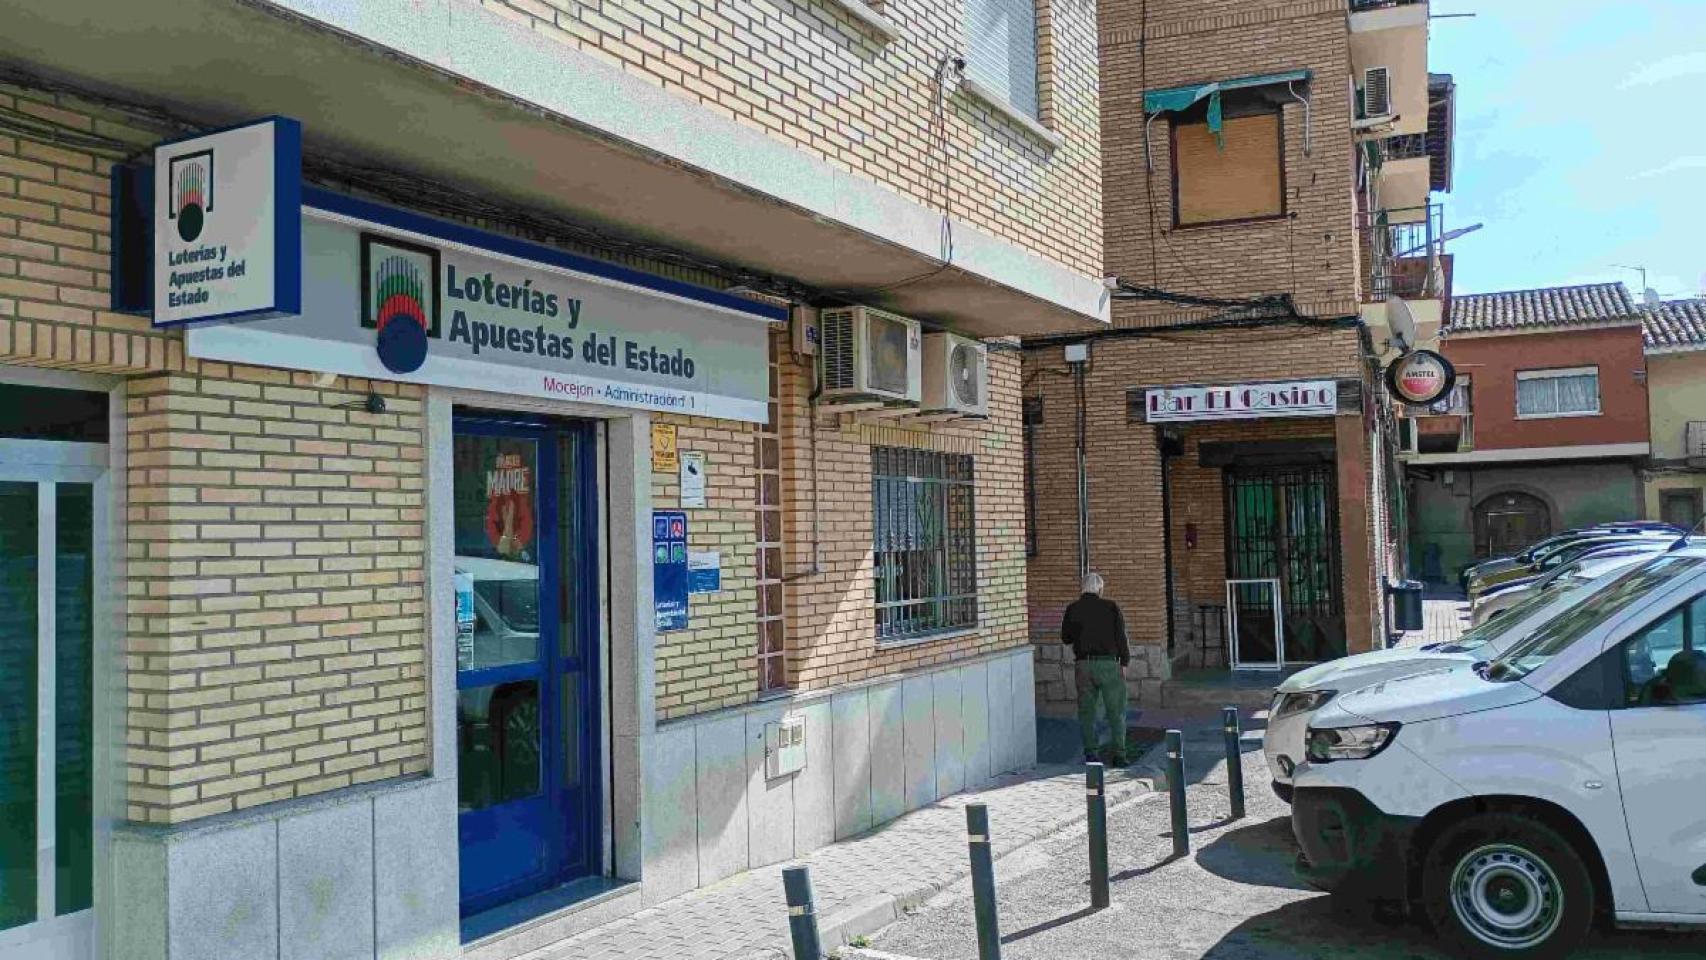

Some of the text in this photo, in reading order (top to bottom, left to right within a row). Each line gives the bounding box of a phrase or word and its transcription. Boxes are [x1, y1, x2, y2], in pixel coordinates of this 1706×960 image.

[168, 244, 227, 267] Loterías y
[168, 258, 246, 290] Apuestas del
[168, 287, 209, 308] Estado
[447, 264, 582, 329] Loterías y
[449, 309, 695, 379] Apuestas del Estado
[1405, 370, 1435, 378] AMSTEL
[1151, 386, 1333, 412] Bar El Casino
[487, 467, 530, 496] MADRE
